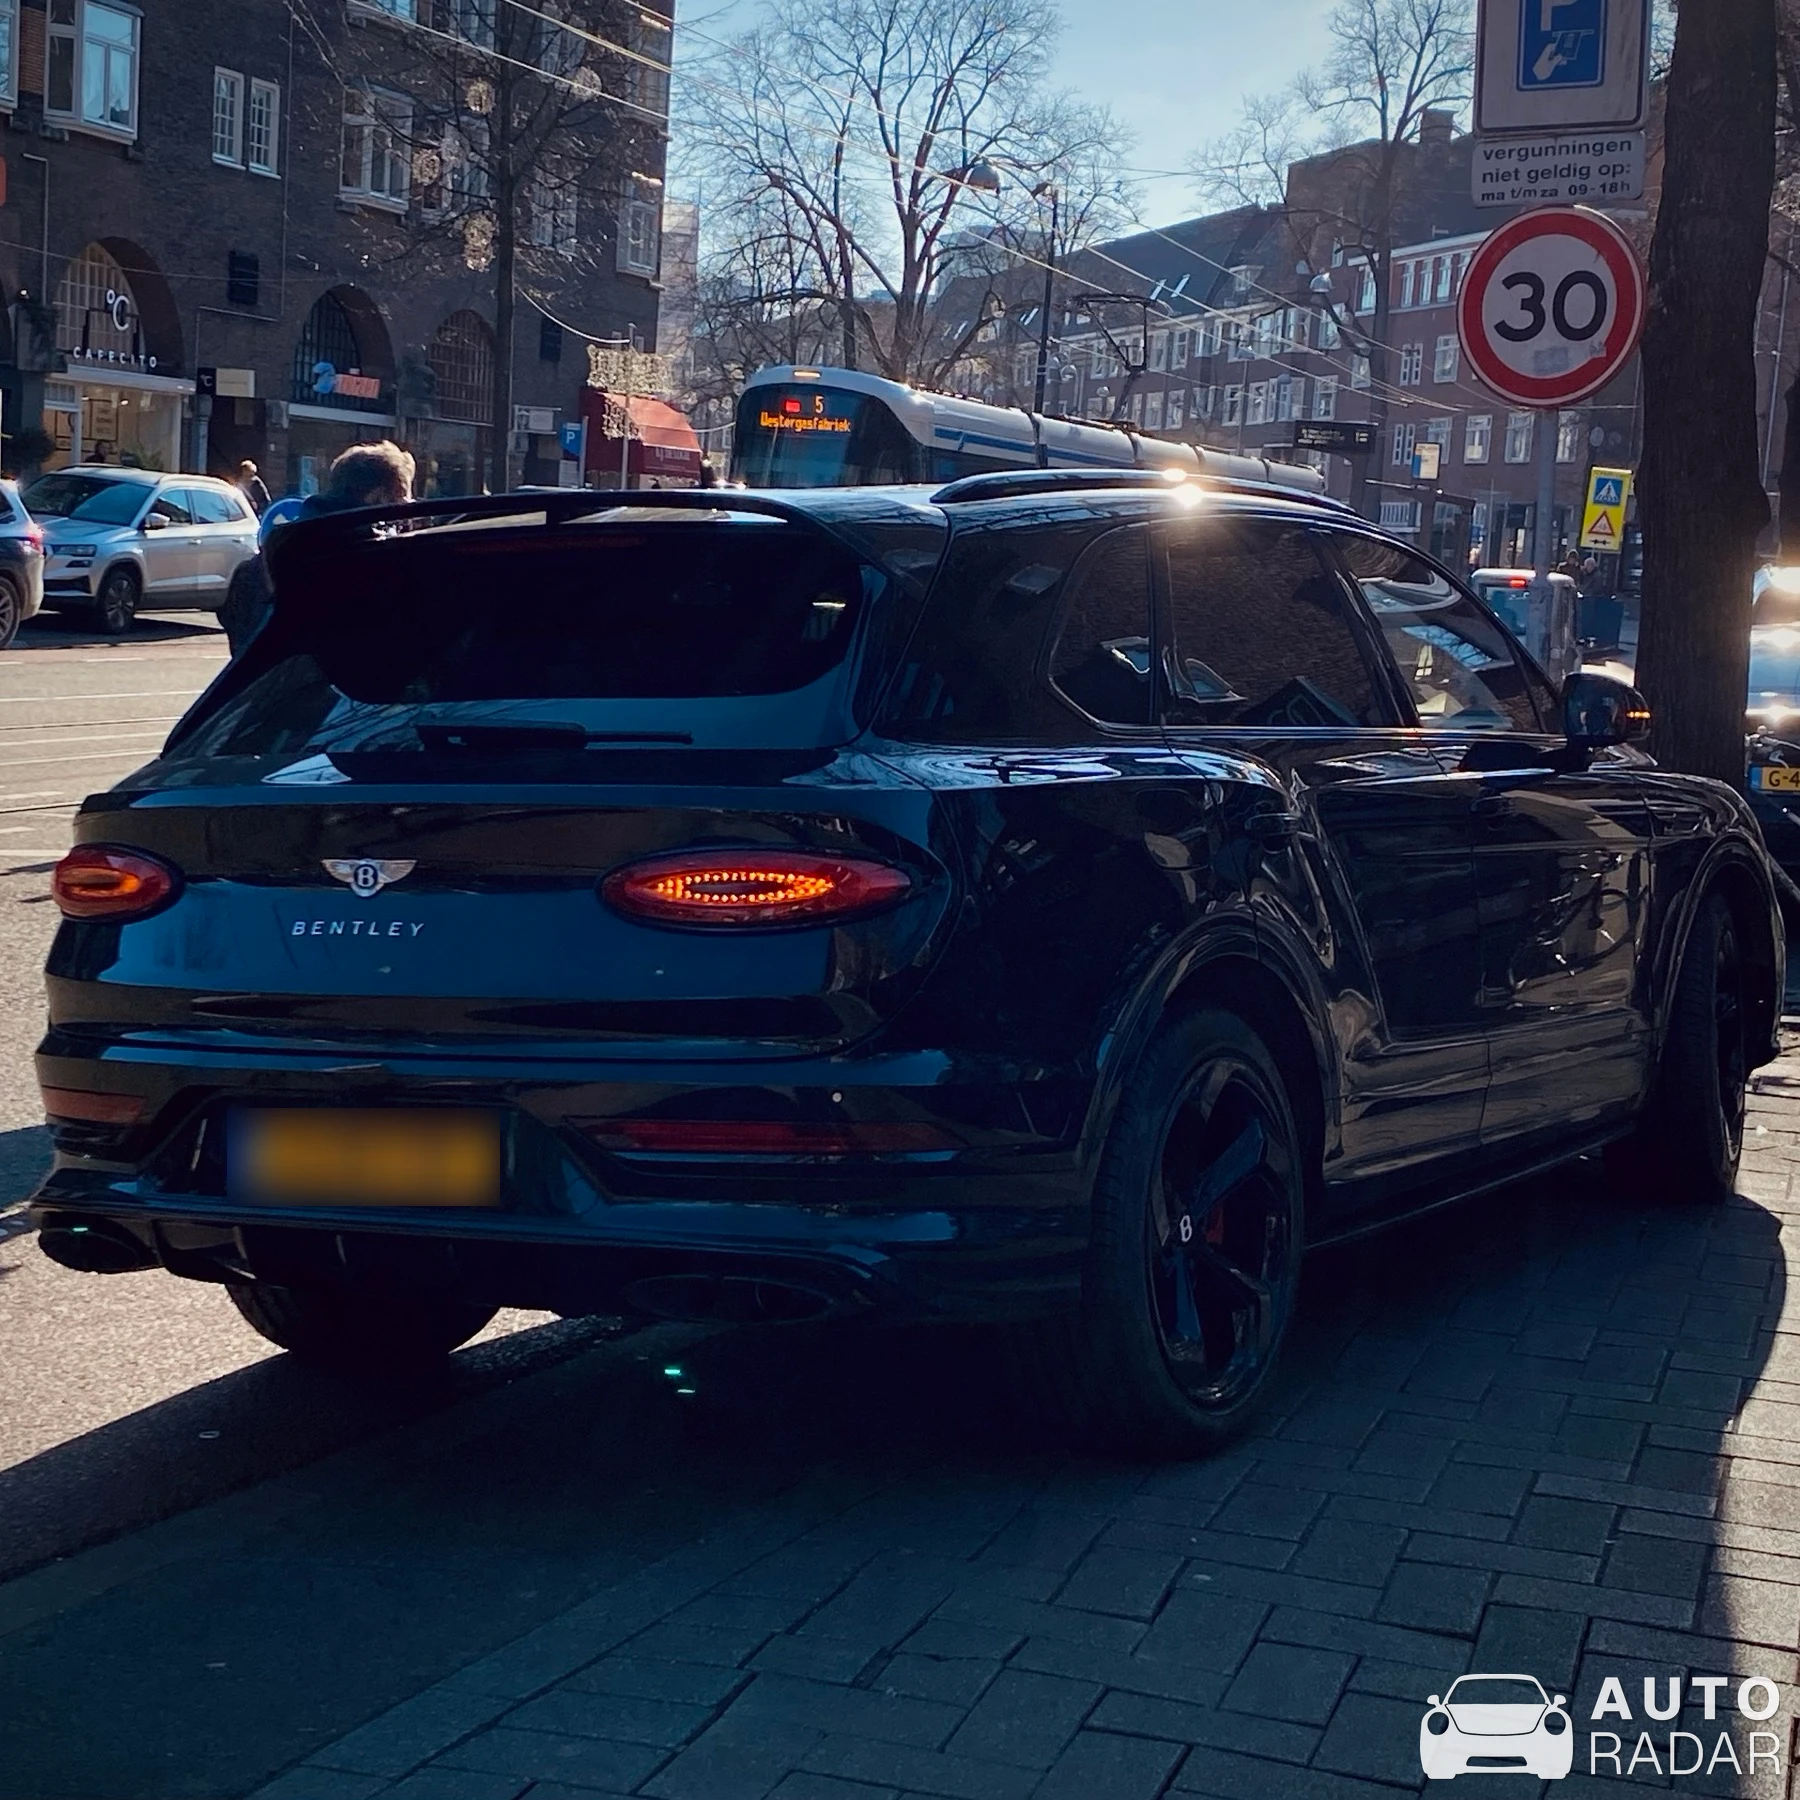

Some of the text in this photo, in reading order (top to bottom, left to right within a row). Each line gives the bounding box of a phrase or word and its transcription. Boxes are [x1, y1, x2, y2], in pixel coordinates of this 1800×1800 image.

[1482, 140, 1632, 161] vergunningen
[1482, 162, 1631, 184] niet geldig op:
[1481, 191, 1506, 202] ma
[1493, 270, 1608, 342] 30
[73, 346, 158, 369] CAFECITO
[815, 395, 825, 414] 5
[566, 431, 576, 444] P
[291, 920, 425, 937] BENTLEY
